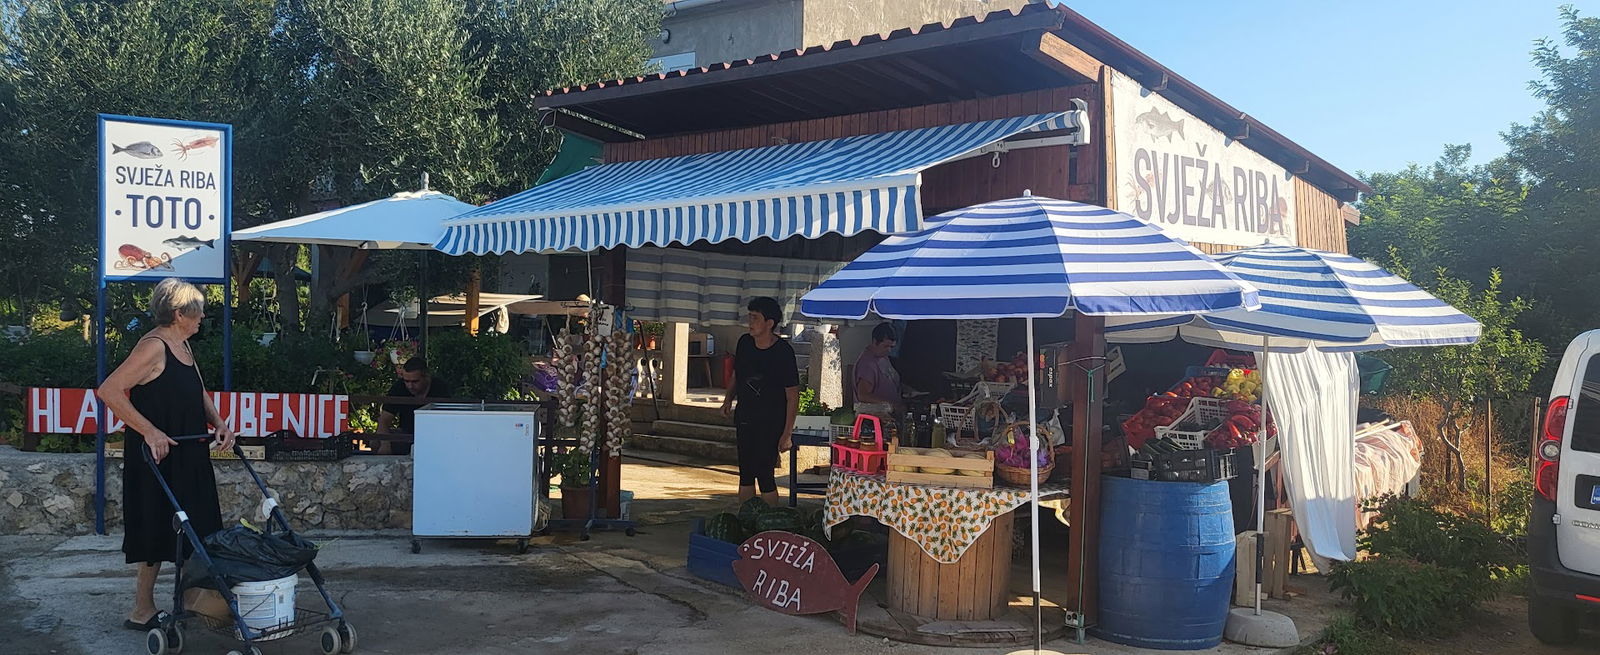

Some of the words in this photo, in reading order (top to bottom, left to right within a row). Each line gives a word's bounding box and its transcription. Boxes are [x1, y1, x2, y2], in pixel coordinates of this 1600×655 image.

[115, 164, 175, 188] SVJEŽA
[180, 170, 216, 190] RIBA
[1134, 142, 1227, 230] SVJEŽA
[1233, 166, 1284, 235] RIBA
[126, 194, 202, 230] TOTO
[750, 538, 815, 574] SVJEŽA
[752, 569, 801, 611] RIBA
